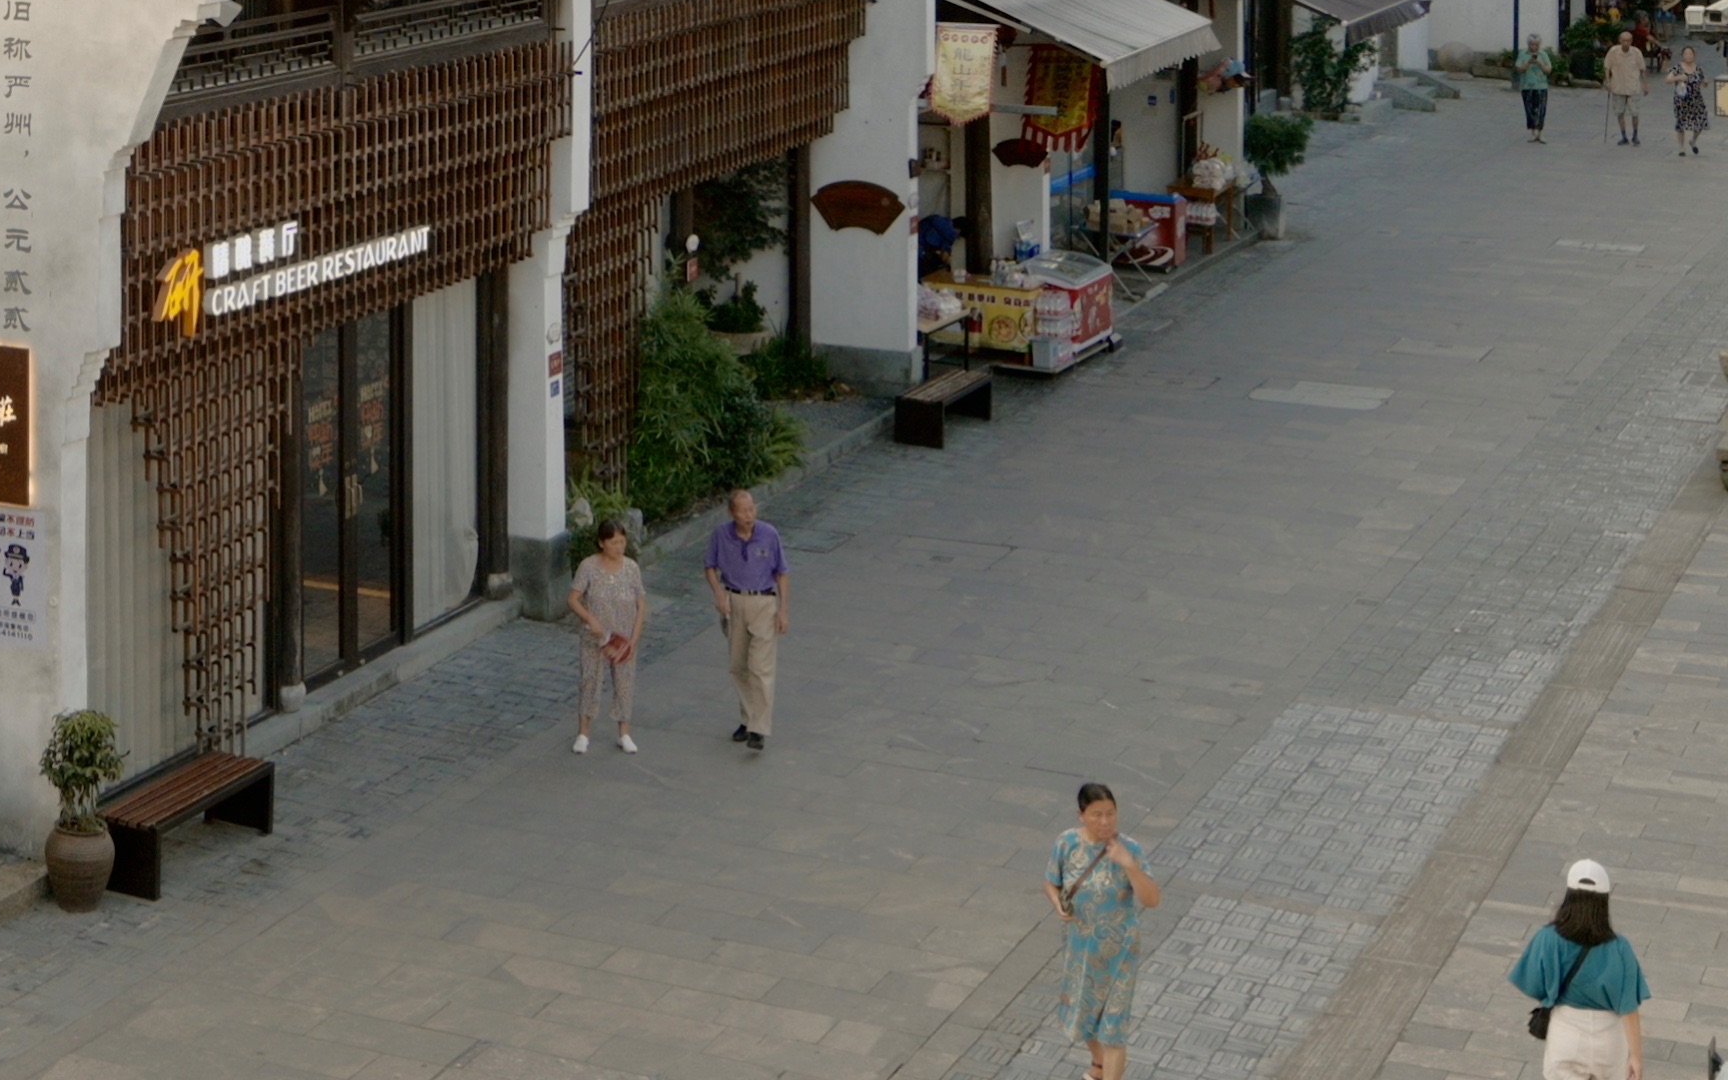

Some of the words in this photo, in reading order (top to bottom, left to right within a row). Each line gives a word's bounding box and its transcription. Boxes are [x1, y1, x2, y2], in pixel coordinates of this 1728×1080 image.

[212, 274, 271, 316] CRAFT
[275, 261, 319, 297] BEER
[322, 226, 430, 283] RESTAURANT
